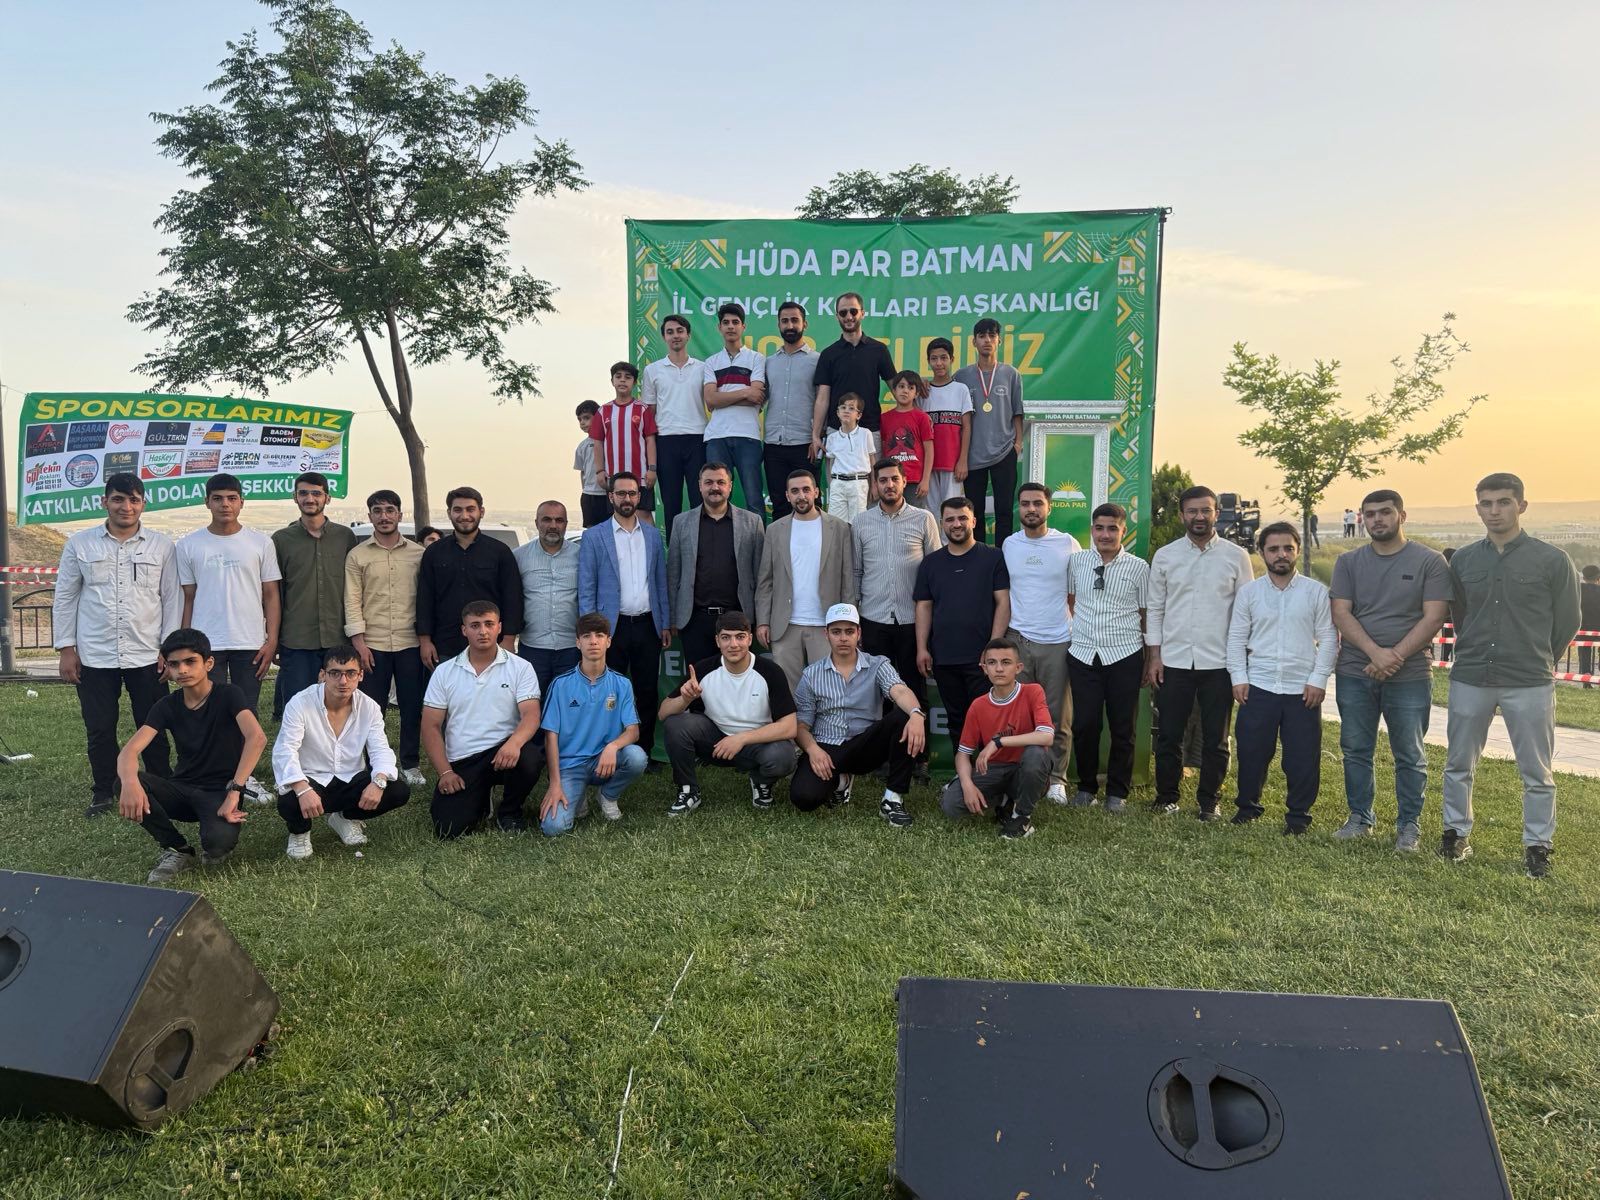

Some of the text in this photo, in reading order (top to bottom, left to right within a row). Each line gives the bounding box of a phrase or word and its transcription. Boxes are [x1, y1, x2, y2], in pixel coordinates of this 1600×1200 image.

[735, 242, 1033, 277] HÜDA PAR BATMAN
[672, 291, 693, 315] İL
[818, 296, 928, 317] KLARI
[935, 286, 1099, 317] BAŞKANLIĞI
[34, 399, 342, 429] SPONSORLARIMIZ
[148, 432, 188, 442] GÜLTEKİN
[263, 436, 299, 444] OTOMOTİV
[234, 452, 260, 461] PERON
